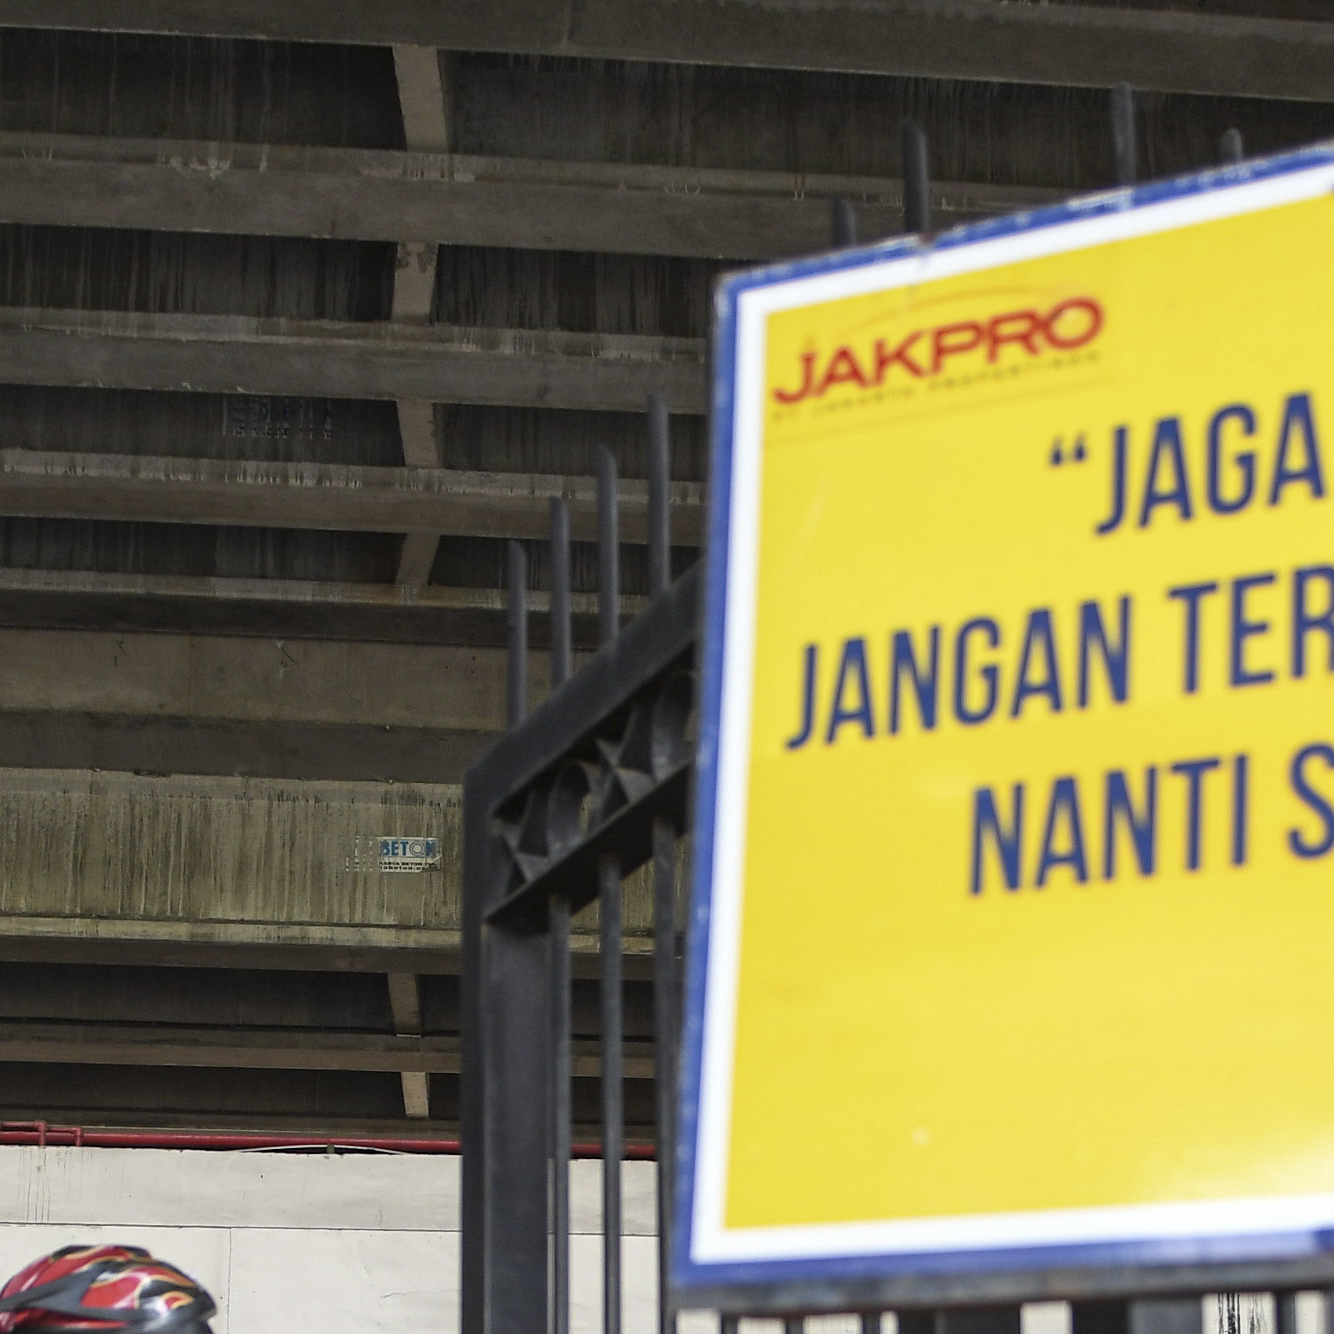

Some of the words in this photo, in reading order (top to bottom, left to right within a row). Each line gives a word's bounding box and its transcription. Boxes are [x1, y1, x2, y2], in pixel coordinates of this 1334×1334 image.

[771, 295, 1105, 405] JAKPRO
[1048, 391, 1327, 537] “JAGA
[784, 594, 1132, 752] JANGAN
[380, 839, 438, 858] BETON
[968, 752, 1250, 897] NANTI
